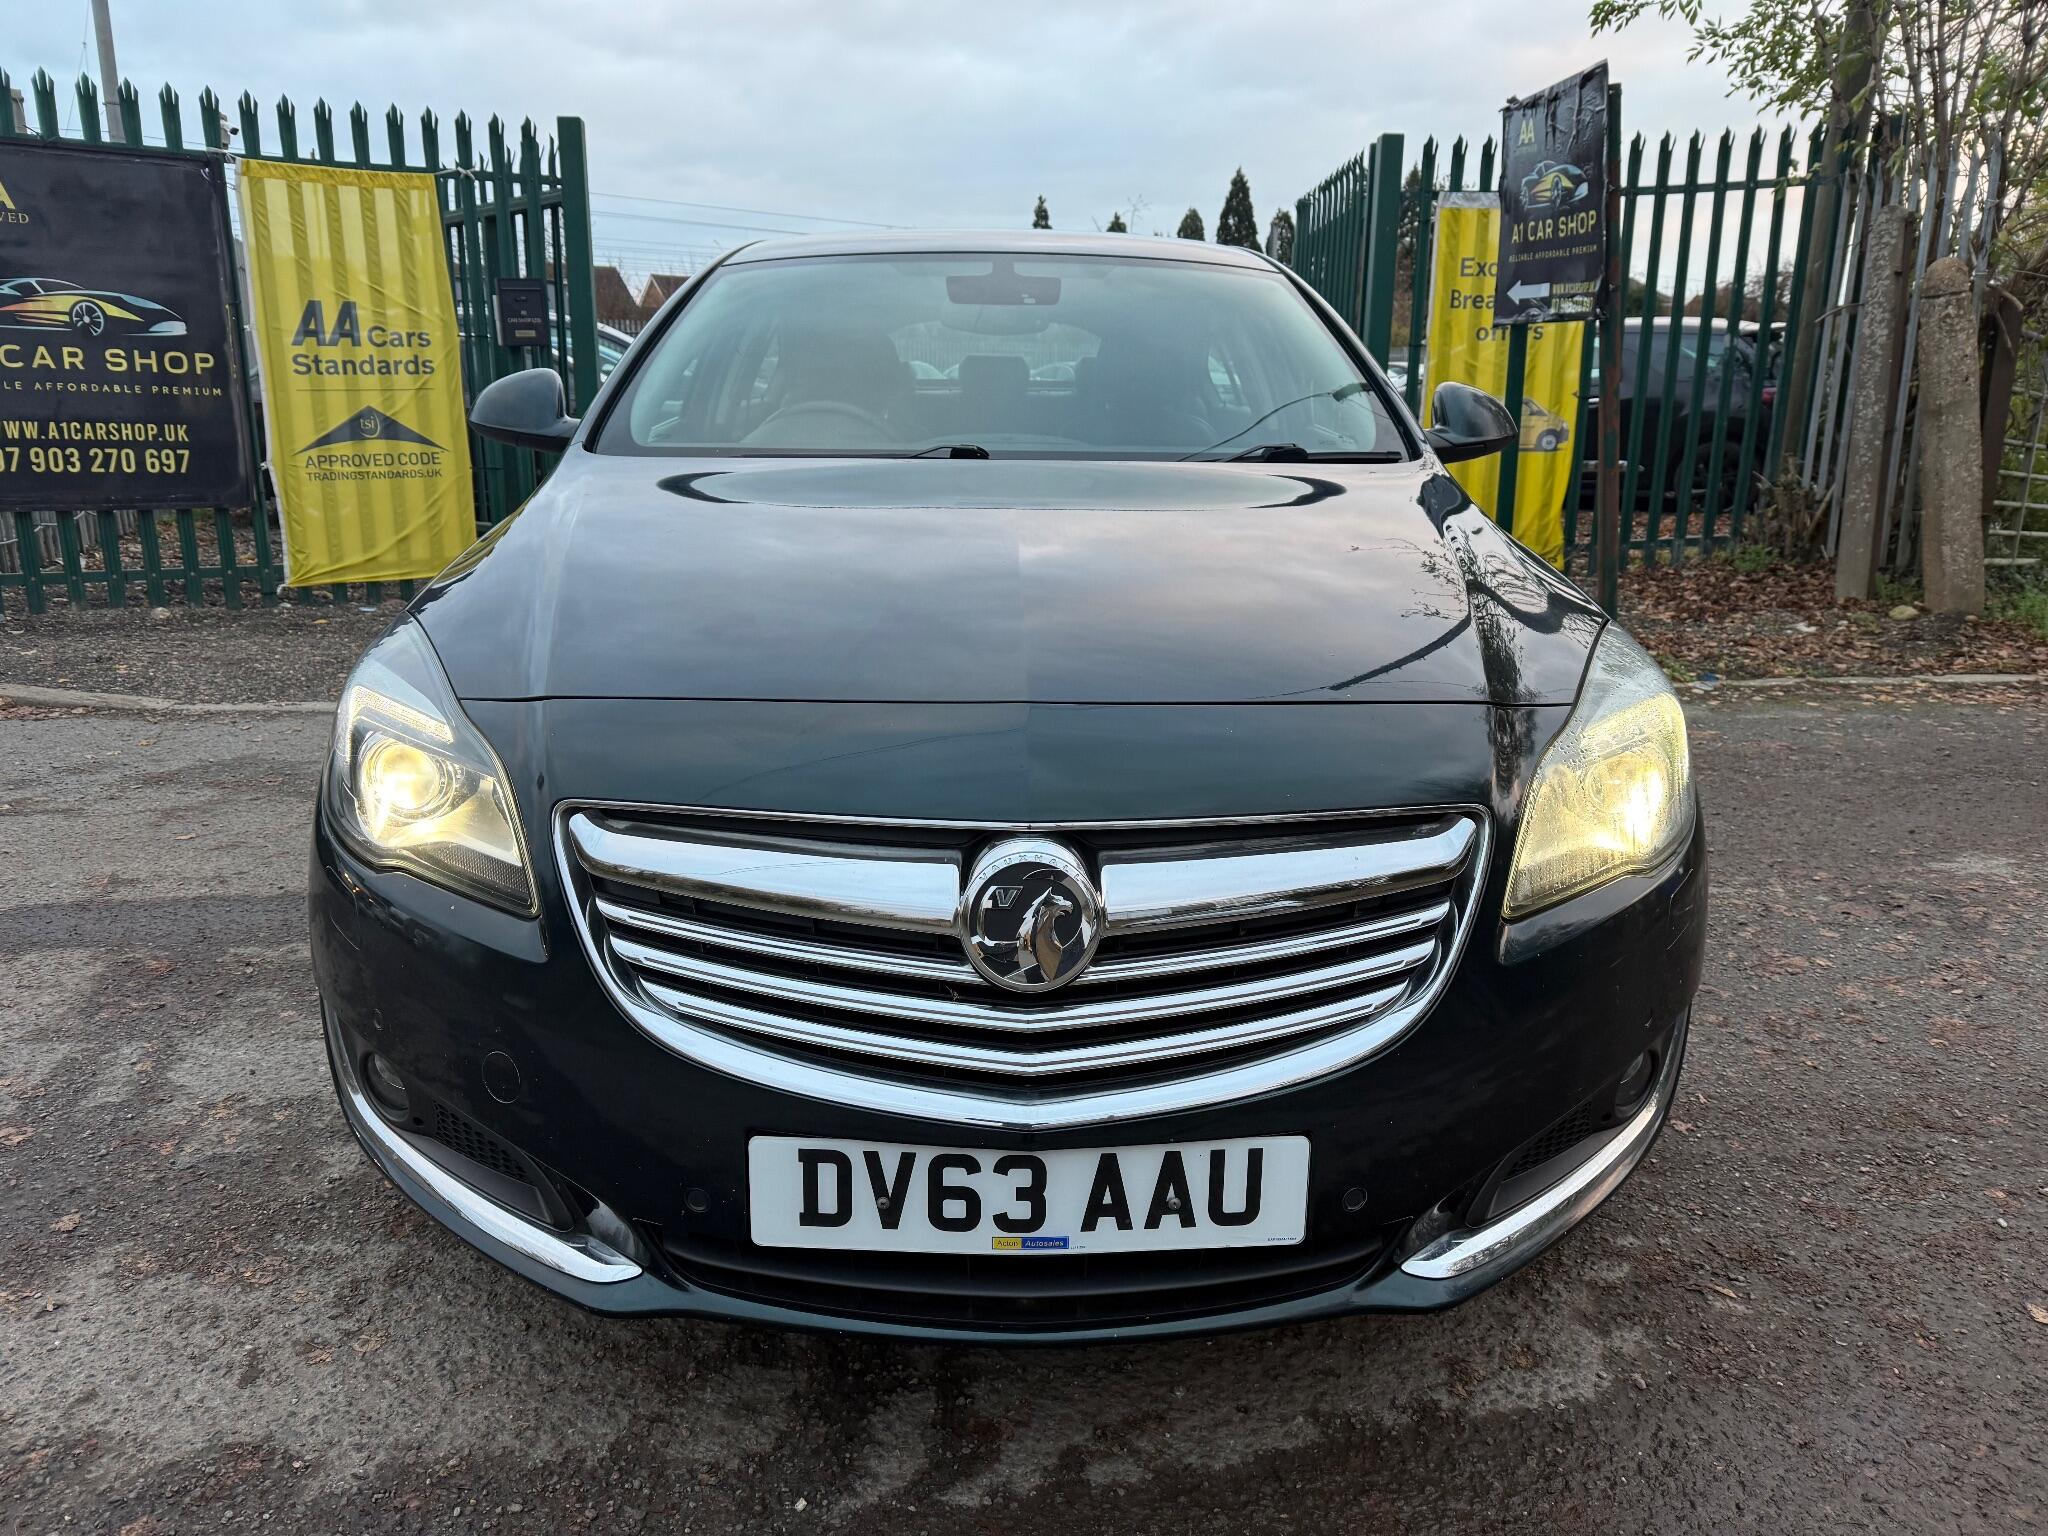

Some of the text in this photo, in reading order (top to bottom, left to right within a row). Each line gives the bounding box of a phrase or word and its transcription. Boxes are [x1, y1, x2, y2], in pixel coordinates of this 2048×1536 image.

[1519, 118, 1535, 145] AA
[1511, 210, 1597, 244] A1 CAR SHOP
[1460, 257, 1498, 277] Exc
[1450, 289, 1495, 309] Brea
[291, 300, 431, 348] AA Cars
[0, 344, 215, 375] CAR SHOP
[291, 354, 435, 376] Standards
[34, 382, 142, 394] AFFORDABLE
[152, 385, 222, 396] PREMIUM
[3, 420, 189, 442] WW.A1CARSHOP.UK
[29, 447, 81, 473] 903
[89, 448, 136, 473] 270
[145, 449, 190, 474] 697
[305, 452, 441, 468] APPROVED CODE
[306, 469, 442, 481] TRADINGSTANDARDS.UK
[798, 1148, 1264, 1233] DV63 AAU
[1025, 1239, 1064, 1247] Autosales
